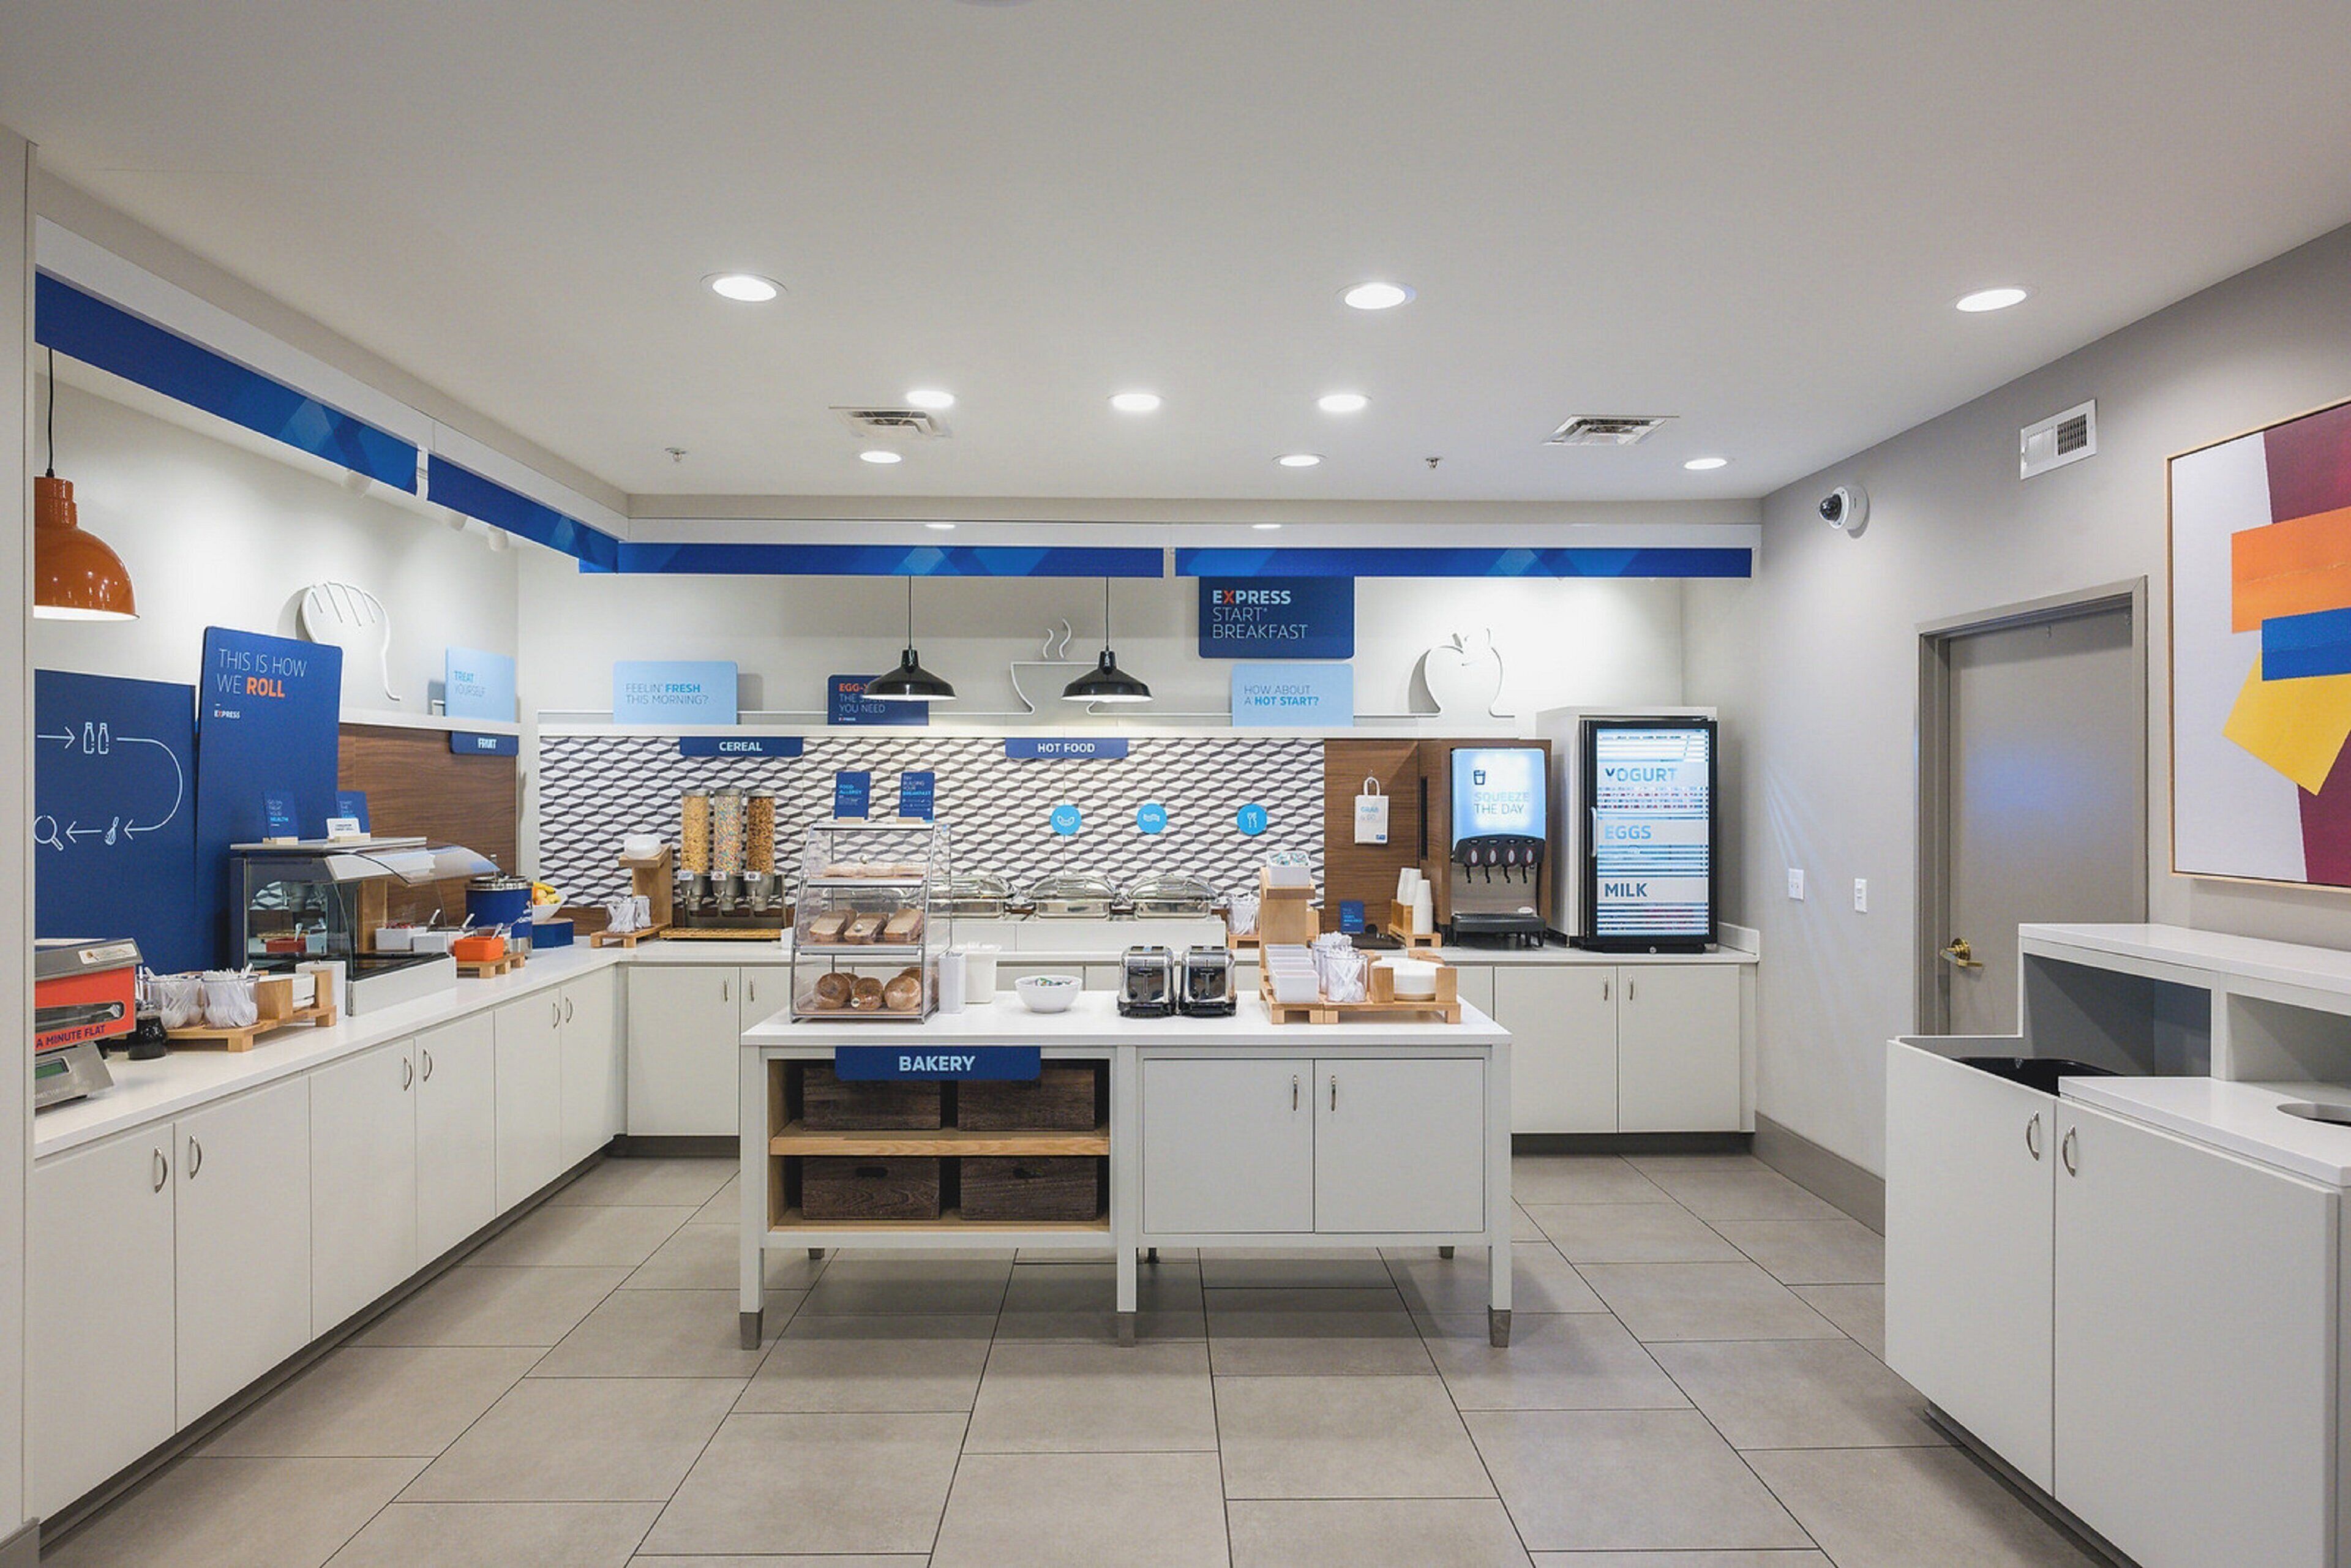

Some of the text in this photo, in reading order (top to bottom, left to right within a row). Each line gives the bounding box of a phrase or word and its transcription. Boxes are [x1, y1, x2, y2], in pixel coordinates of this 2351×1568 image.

[1212, 590, 1291, 605] EXPRESS
[1212, 624, 1308, 639] BREAKFAST
[218, 648, 307, 678] THIS IS HOW
[217, 673, 286, 698] WE ROLL
[625, 683, 700, 693] FEELIN' FRESH
[1243, 685, 1311, 694] HOW ABOUT
[626, 694, 709, 705] THIS MORNING?
[1244, 696, 1319, 705] A HOT START?
[214, 710, 241, 719] EXPRESS
[839, 703, 885, 714] YOU NEED
[478, 737, 497, 749] FRUIT
[719, 741, 763, 751] CEREAL
[1038, 743, 1095, 753] HOT FOOD
[1605, 768, 1678, 782] YOGURT
[1474, 791, 1531, 803] SQUEEZE
[1474, 803, 1524, 814] THE DAY
[1605, 825, 1651, 839] EGGS
[1605, 883, 1648, 897] MILK
[36, 1024, 106, 1048] A MINUTE FLAT
[898, 1056, 976, 1071] BAKERY
